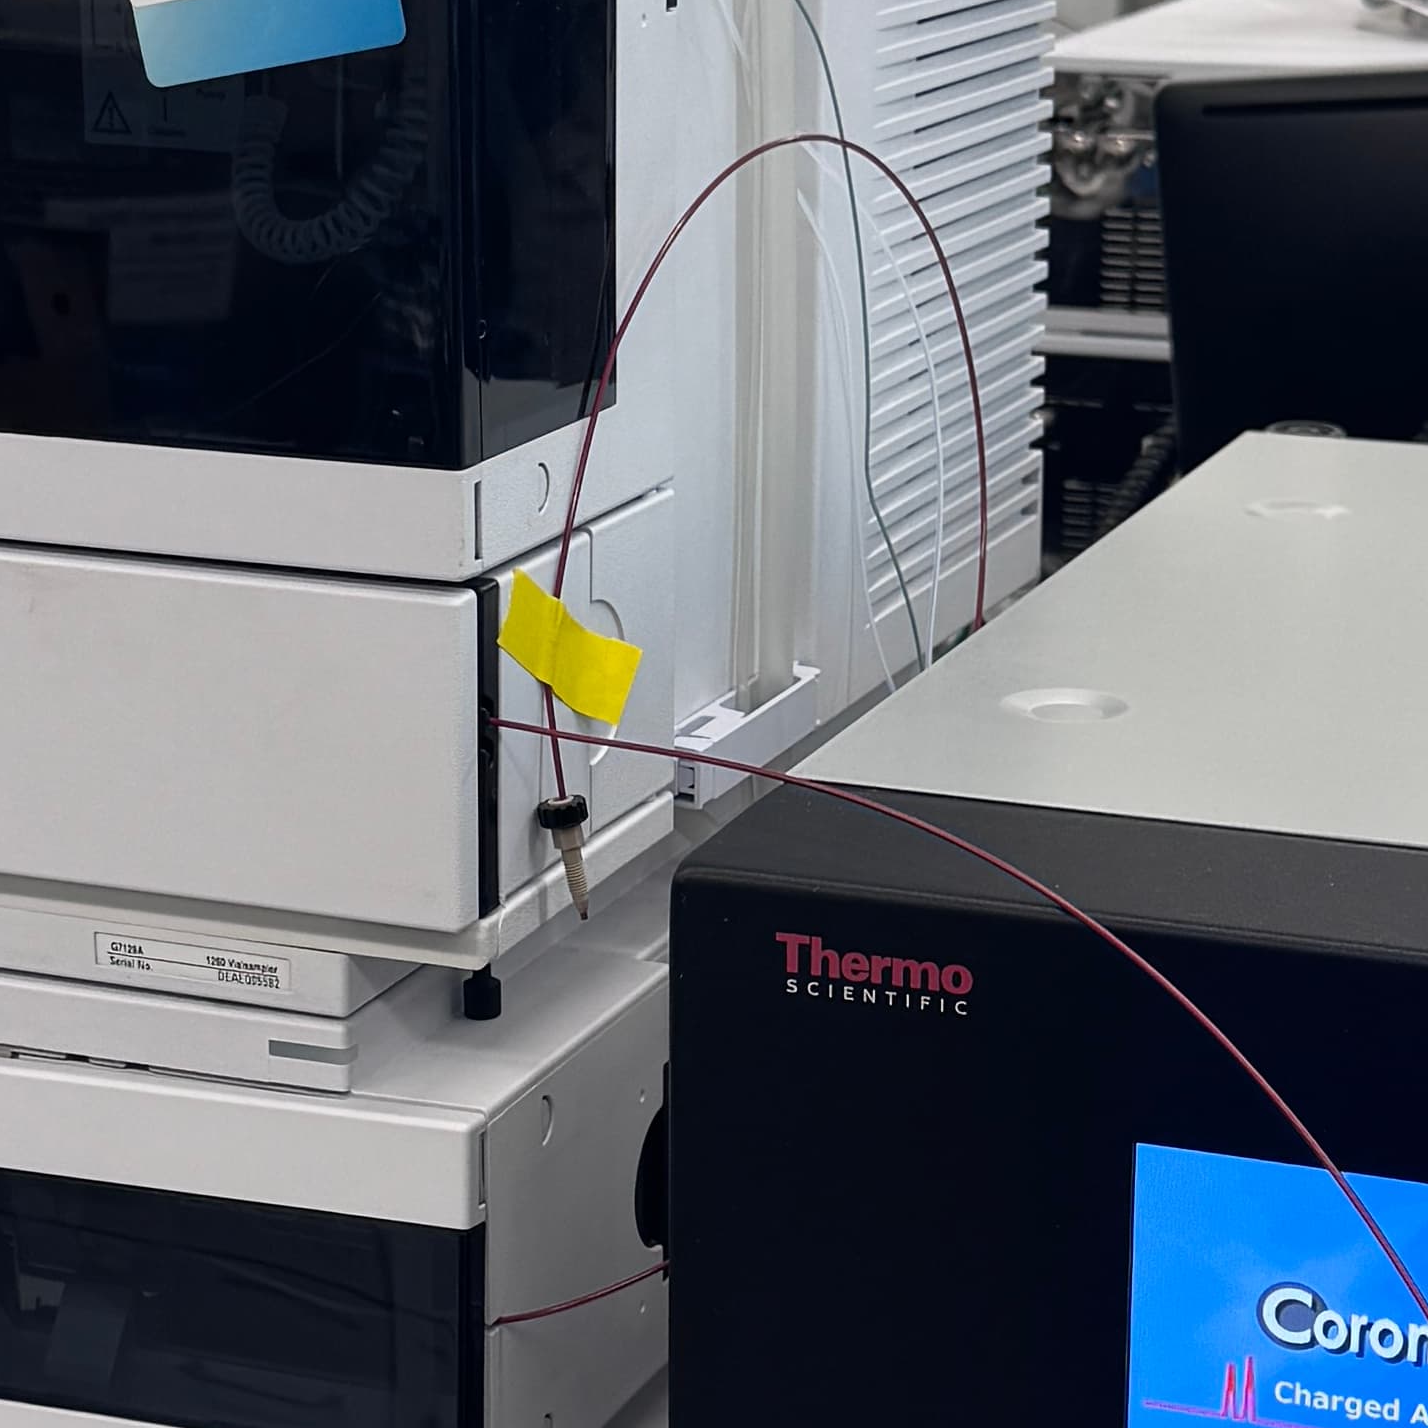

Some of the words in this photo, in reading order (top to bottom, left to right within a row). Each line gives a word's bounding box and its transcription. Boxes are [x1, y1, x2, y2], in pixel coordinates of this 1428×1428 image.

[109, 956, 135, 969] Serial
[775, 931, 974, 995] Thermo
[785, 978, 969, 1016] SCIENTIFIC
[1274, 1380, 1401, 1423] Charged
